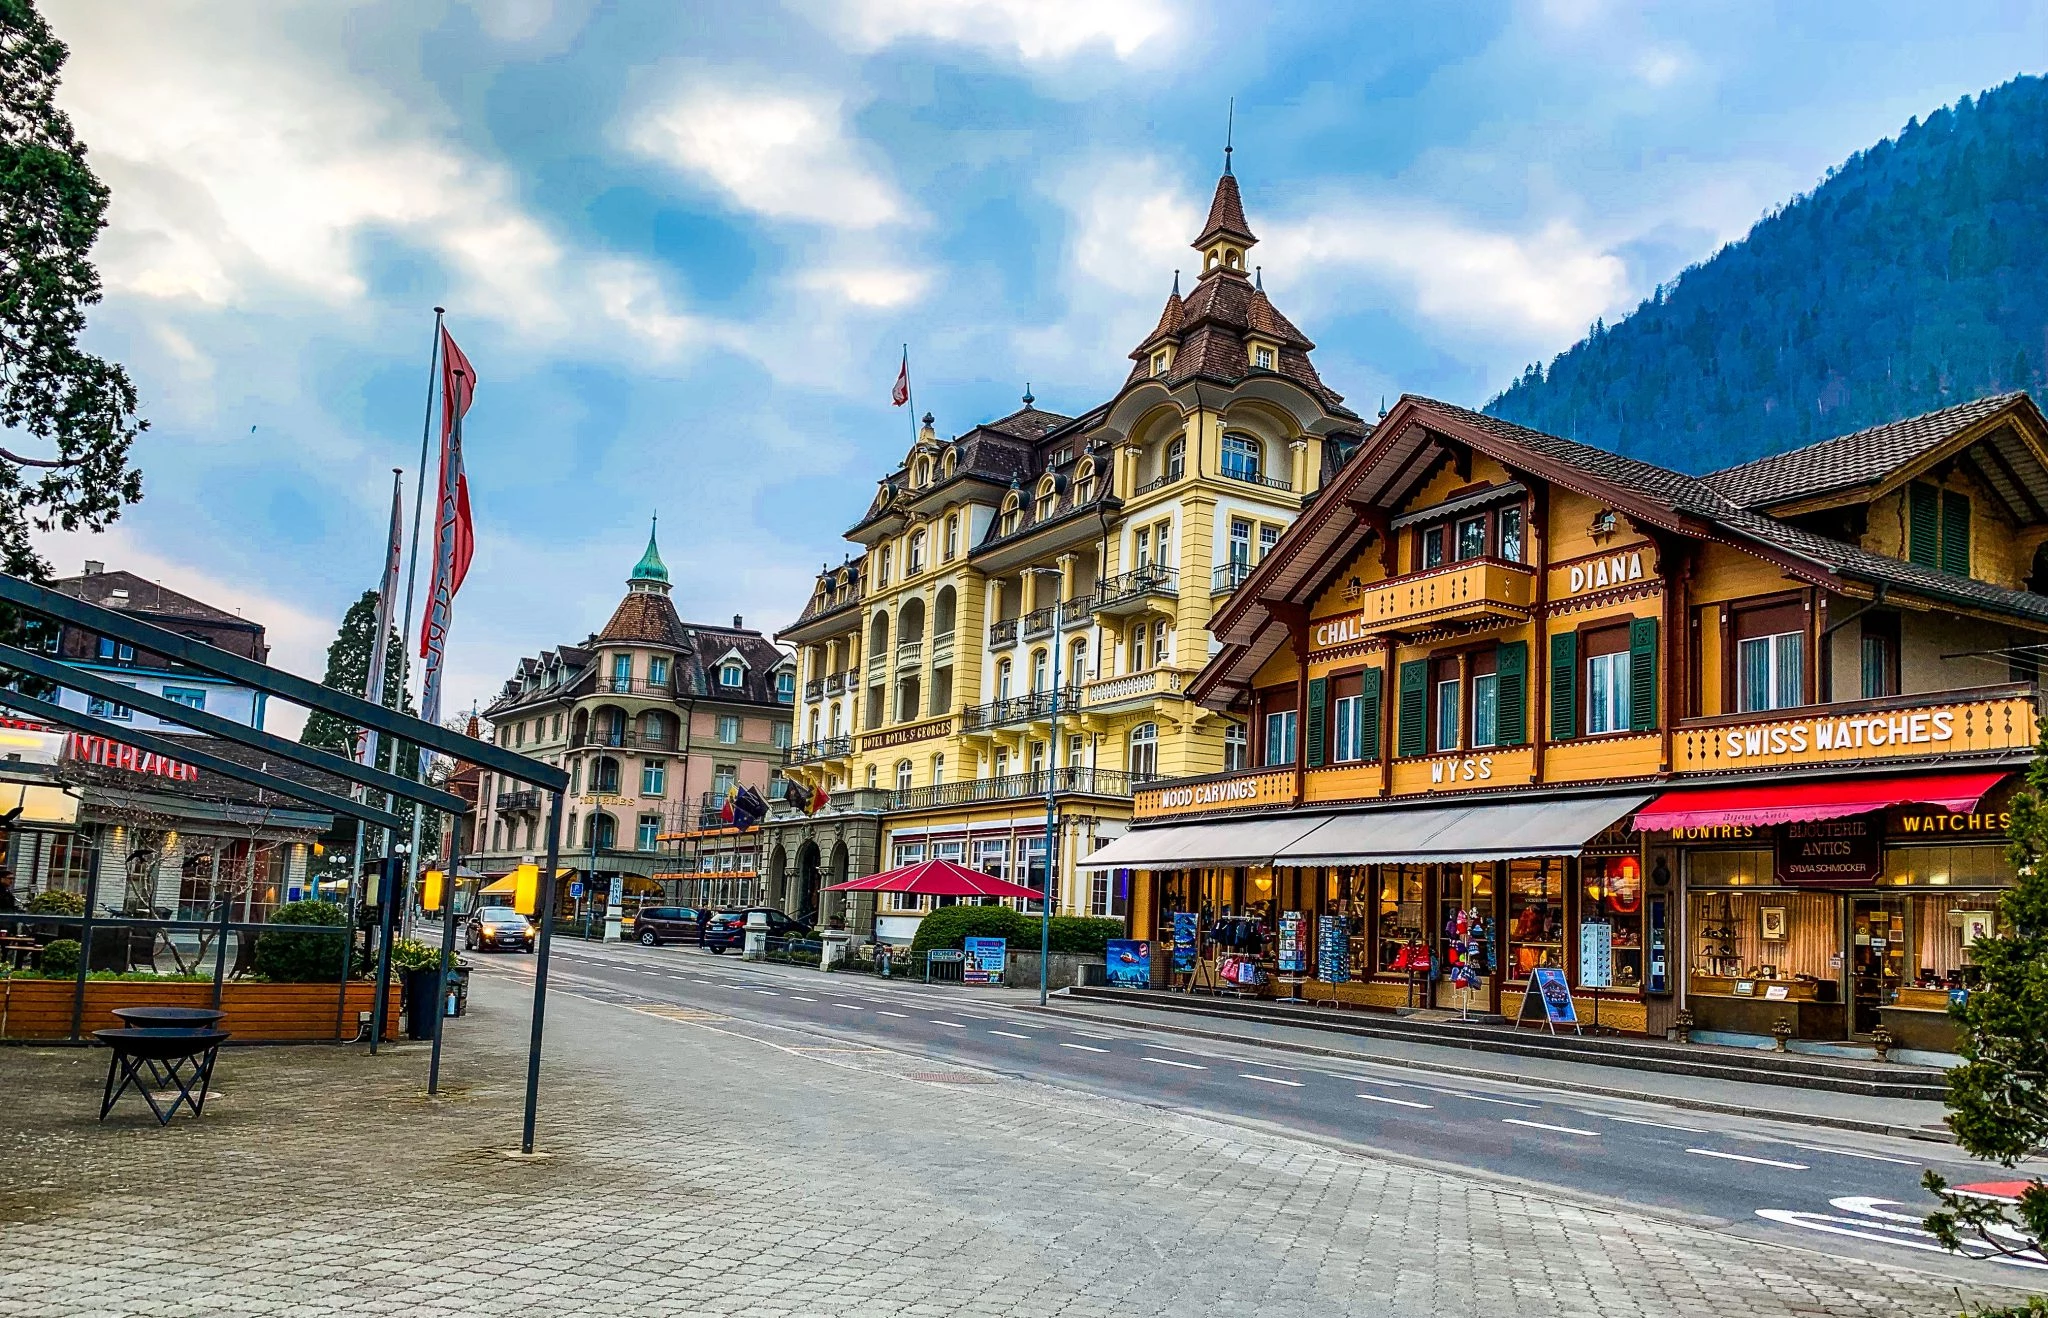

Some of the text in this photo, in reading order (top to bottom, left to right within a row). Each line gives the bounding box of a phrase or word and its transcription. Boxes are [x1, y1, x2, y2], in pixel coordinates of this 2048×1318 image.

[1570, 553, 1642, 593] DIANA
[917, 721, 951, 739] GEORGES
[1726, 711, 1954, 758] SWISS WATCHES
[1432, 757, 1493, 783] WYSS
[1162, 780, 1257, 808] WOOD CARVINGS
[1789, 822, 1867, 838] BIJOUTERIE
[1903, 812, 2011, 831] WATCHES
[1801, 841, 1851, 856] ANTICS
[1789, 863, 1866, 873] SYLVIA SCHMOCKER
